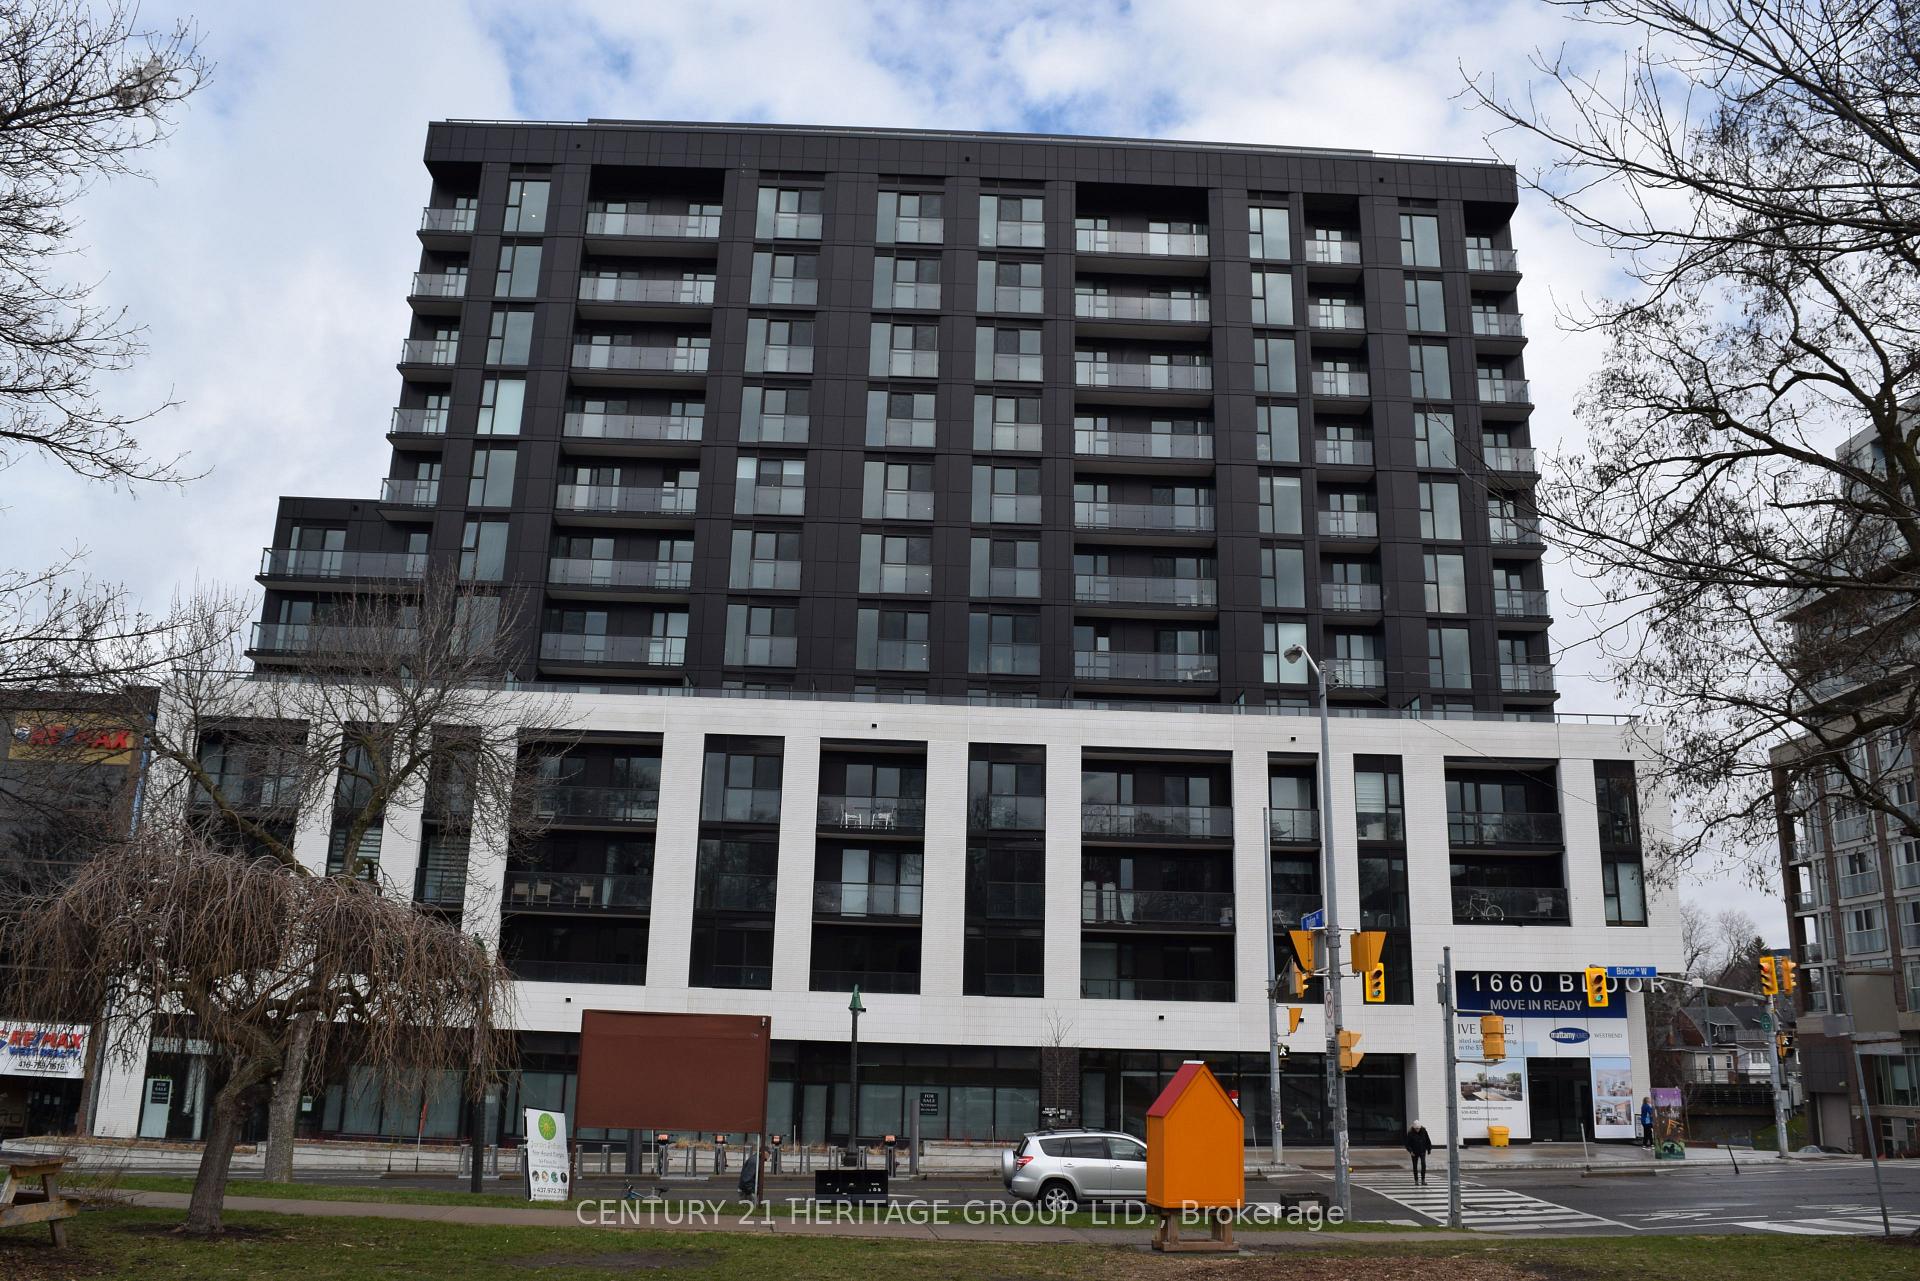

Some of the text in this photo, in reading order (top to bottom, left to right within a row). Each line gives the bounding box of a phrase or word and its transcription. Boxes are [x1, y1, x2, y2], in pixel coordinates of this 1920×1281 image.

[1616, 967, 1635, 976] Bloor
[1640, 967, 1648, 976] W
[1471, 973, 1543, 993] 1660
[1490, 1000, 1582, 1011] MOVE IN READY
[8, 1030, 82, 1049] RE/MAX
